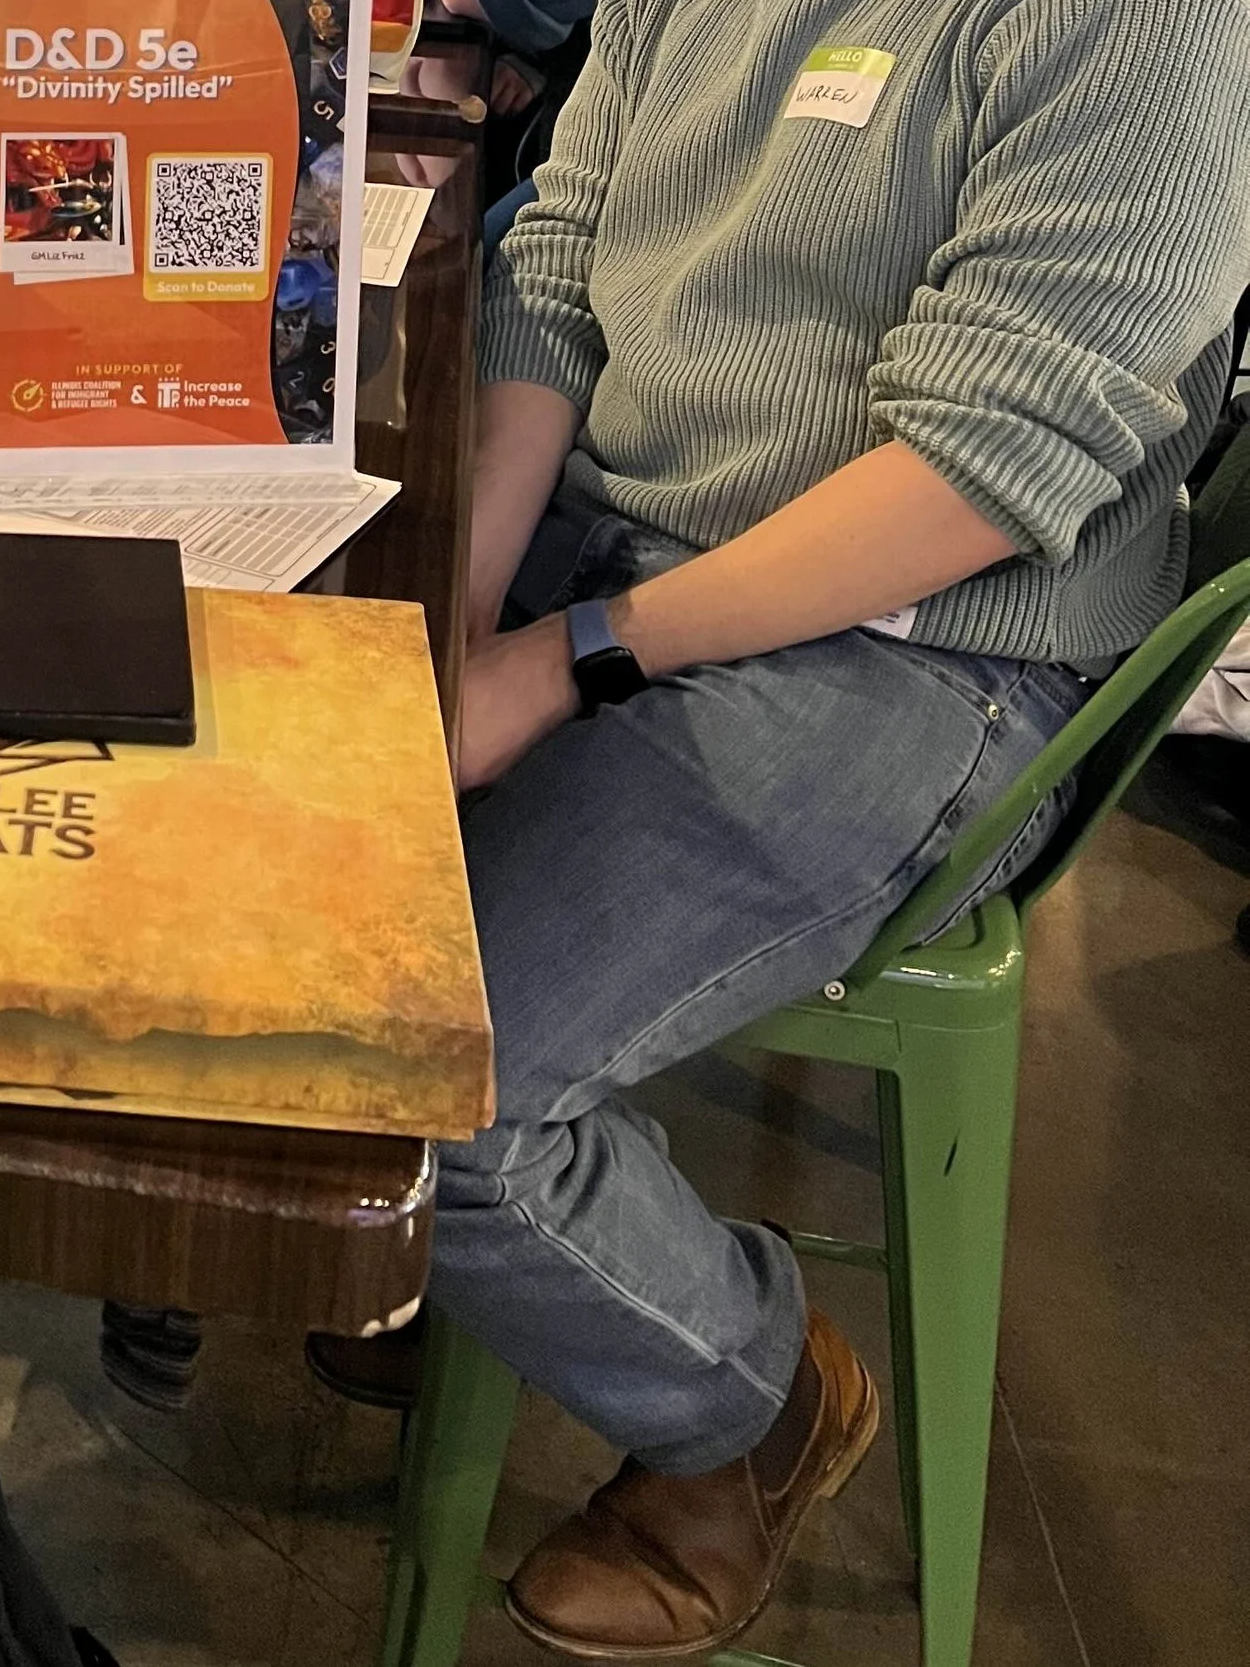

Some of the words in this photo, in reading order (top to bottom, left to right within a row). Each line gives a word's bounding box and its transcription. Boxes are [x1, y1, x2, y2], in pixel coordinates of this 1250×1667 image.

[5, 27, 125, 71] D&D
[136, 28, 198, 71] 5e
[828, 50, 863, 63] HELLO
[2, 75, 122, 104] “Divinity
[127, 75, 234, 104] Spilled”
[796, 85, 859, 104] WARREN
[157, 281, 189, 294] Scan
[191, 282, 204, 293] to
[207, 281, 255, 293] Donate
[76, 365, 90, 375] IN
[95, 364, 159, 376] SUPPORT
[164, 363, 185, 374] OF
[183, 380, 243, 392] Increase
[51, 390, 66, 400] FOR
[130, 384, 148, 405] &
[183, 394, 206, 407] the
[209, 394, 251, 407] Peace
